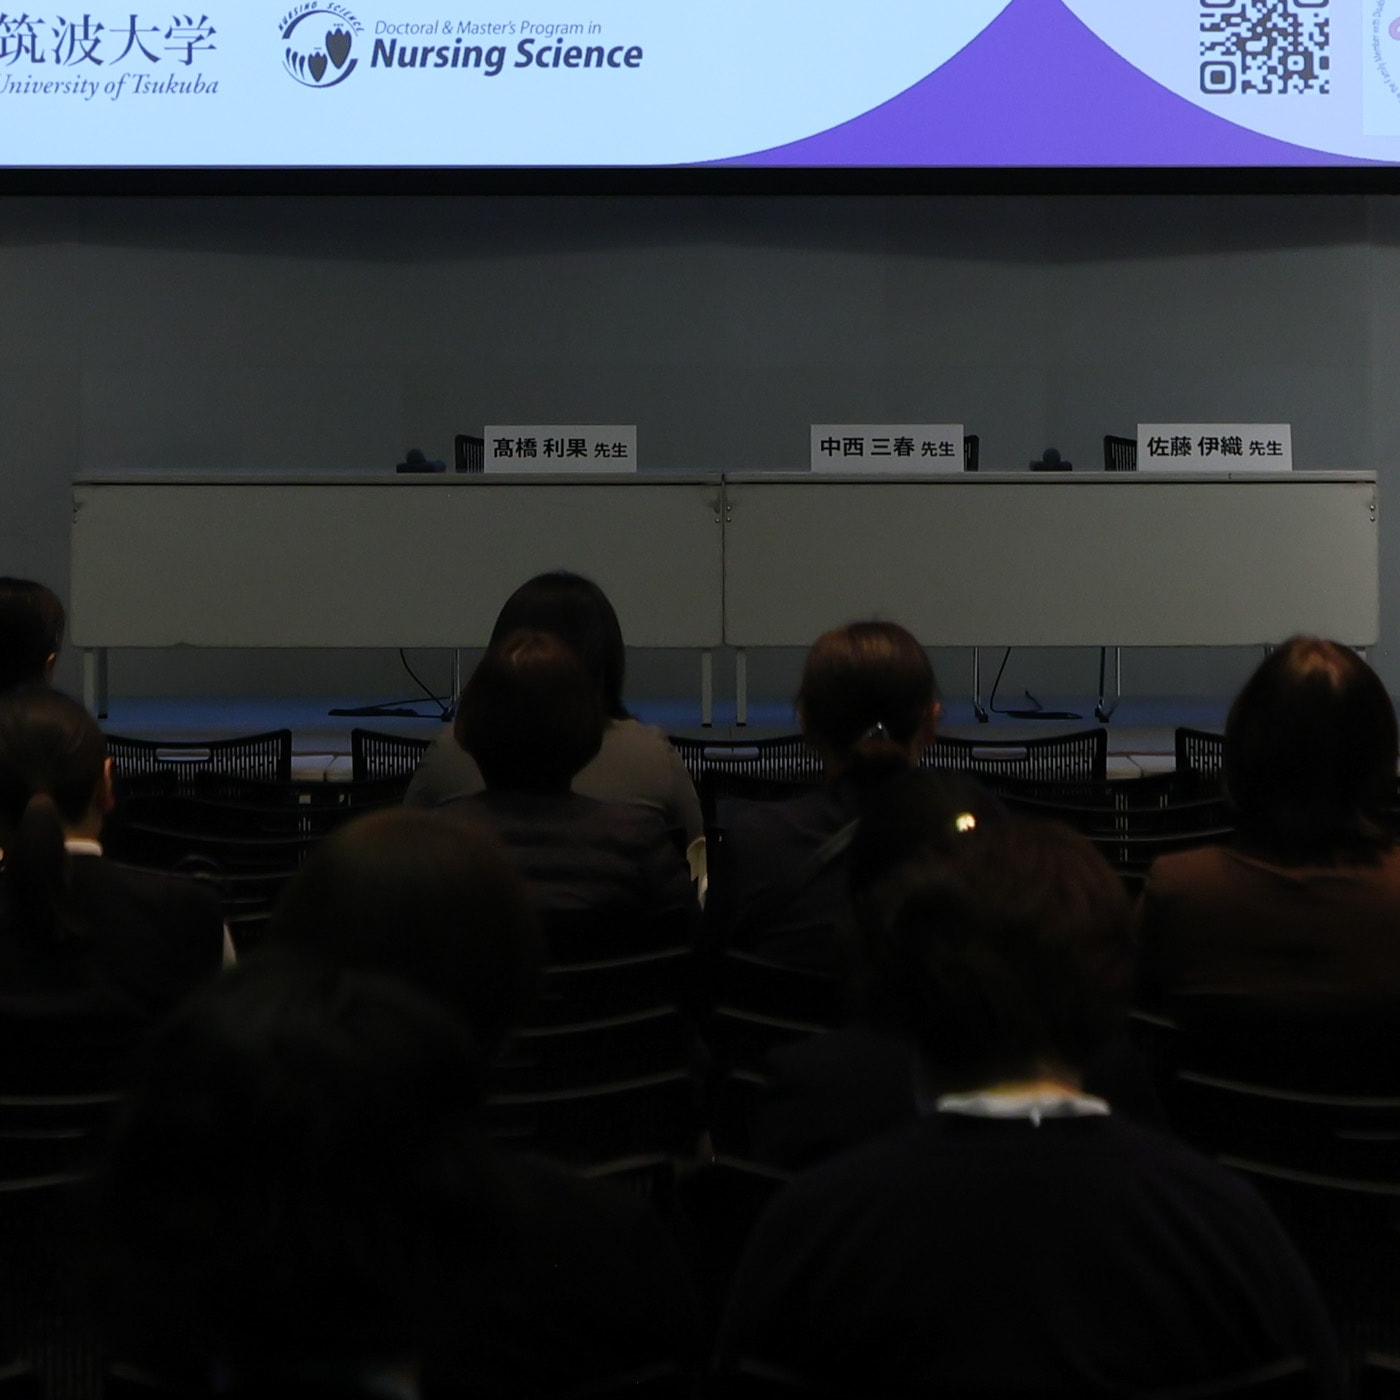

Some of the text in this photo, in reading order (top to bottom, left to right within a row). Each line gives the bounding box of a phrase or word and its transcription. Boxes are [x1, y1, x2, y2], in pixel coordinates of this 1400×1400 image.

[374, 20, 439, 35] Doctoral
[441, 20, 454, 35] &
[520, 20, 584, 38] Program
[588, 20, 602, 35] in
[370, 37, 644, 77] Nursing Science
[103, 72, 131, 101] of
[132, 72, 220, 95] Tsukuba
[543, 437, 588, 458] 利果
[594, 442, 628, 458] 先生
[820, 436, 955, 457] 中西 三春 先生
[1147, 436, 1283, 457] 佐藤 伊織 先生
